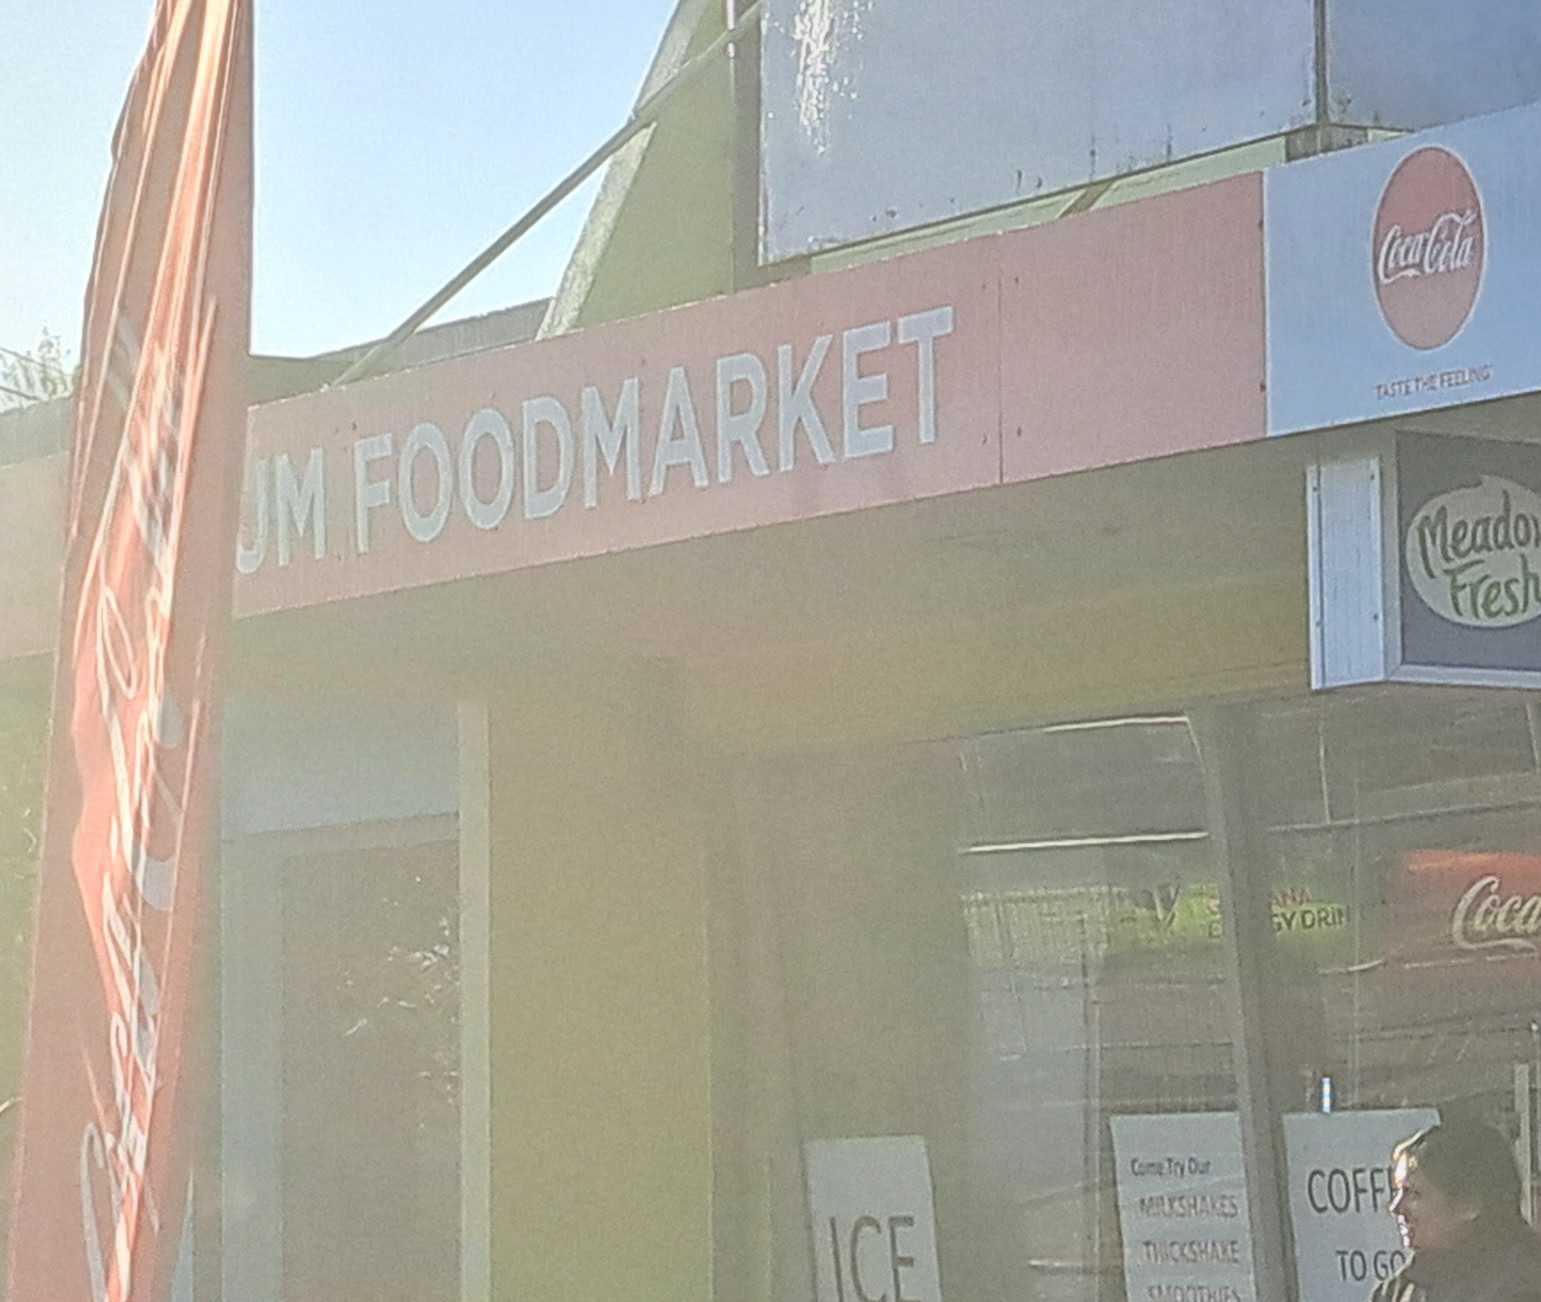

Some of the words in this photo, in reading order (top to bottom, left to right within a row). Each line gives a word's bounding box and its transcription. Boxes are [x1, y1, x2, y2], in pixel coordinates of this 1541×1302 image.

[1378, 208, 1478, 285] Coca-Cola
[235, 447, 326, 576] UM
[353, 306, 954, 554] FOODMARKET
[1307, 1166, 1399, 1214] COFF
[1336, 1249, 1367, 1282] TO
